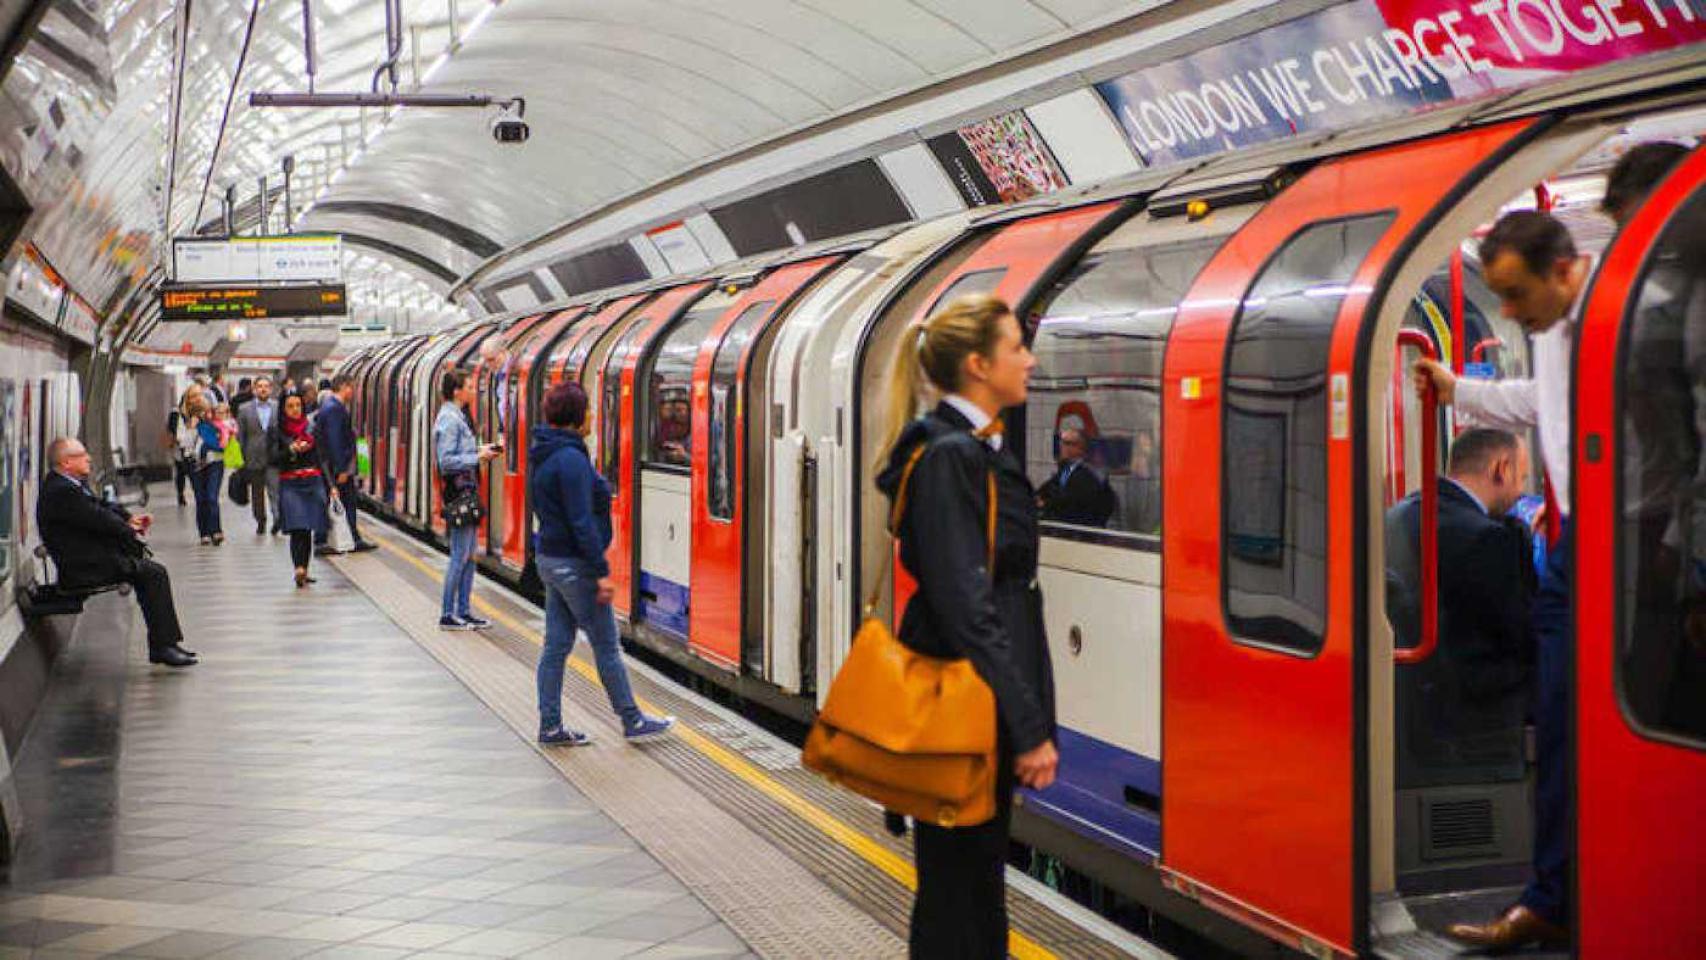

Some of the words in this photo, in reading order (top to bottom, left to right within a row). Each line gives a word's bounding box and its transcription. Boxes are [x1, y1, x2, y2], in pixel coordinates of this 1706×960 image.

[1123, 74, 1268, 151] LONDON
[1248, 59, 1326, 116] WE
[1312, 11, 1496, 105] CHARGE
